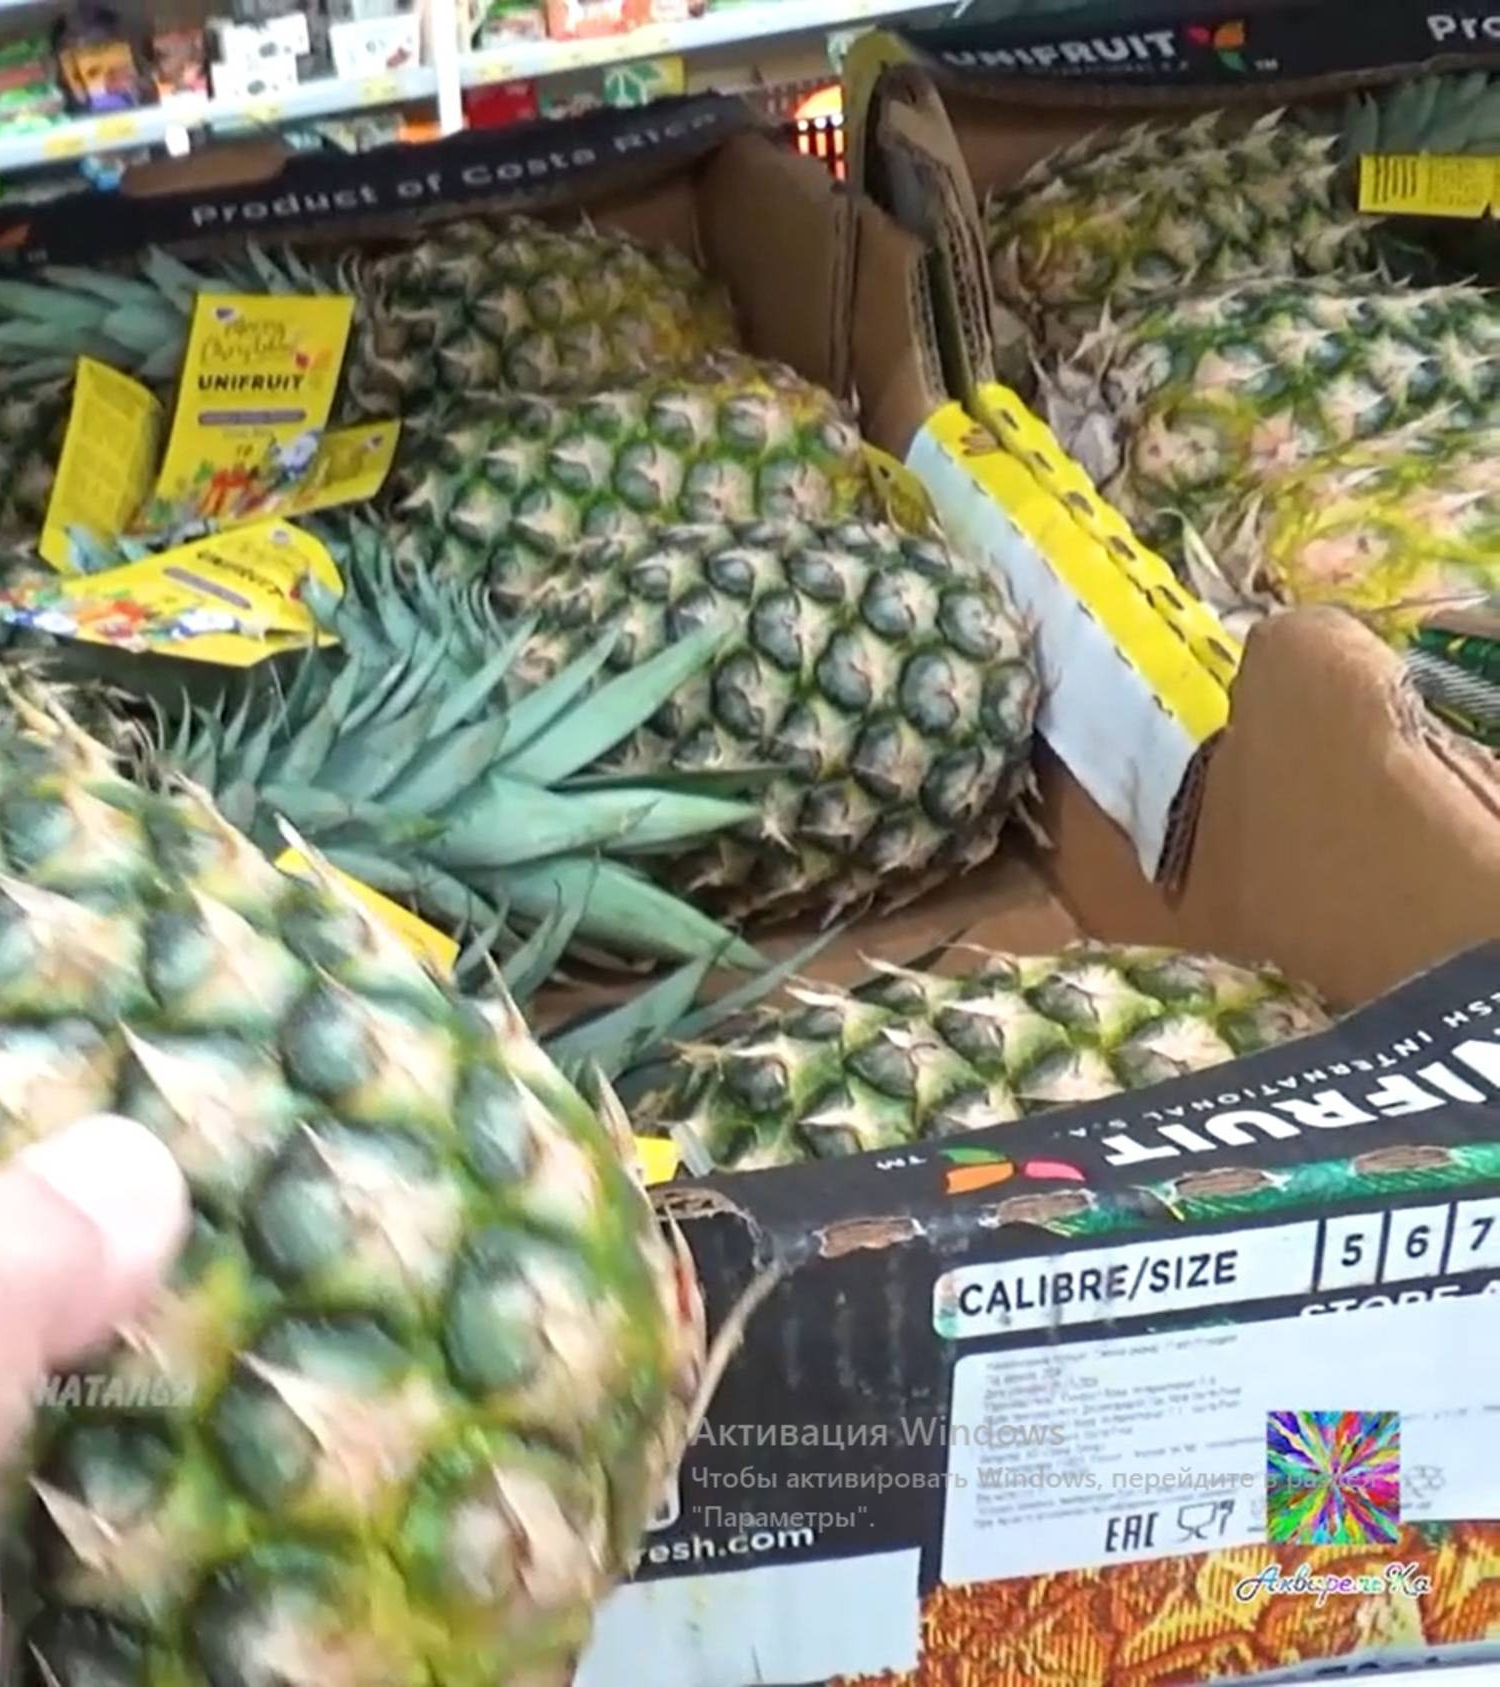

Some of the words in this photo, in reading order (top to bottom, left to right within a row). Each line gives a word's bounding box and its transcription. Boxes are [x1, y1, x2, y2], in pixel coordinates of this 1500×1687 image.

[942, 31, 1176, 67] UNIFRUIT
[191, 183, 378, 228] Product
[397, 173, 442, 199] of
[461, 148, 597, 187] Costa
[613, 112, 717, 153] Rica
[199, 373, 305, 391] UNIFRUIT
[1142, 1030, 1434, 1121] INTERNATIONAL
[1341, 1233, 1365, 1267] 5
[1405, 1225, 1431, 1258] 6
[1471, 1216, 1495, 1251] 7
[958, 1250, 1239, 1318] CALIBRE/SIZE
[648, 1526, 816, 1564] esh.com
[1104, 1511, 1160, 1553] EAC
